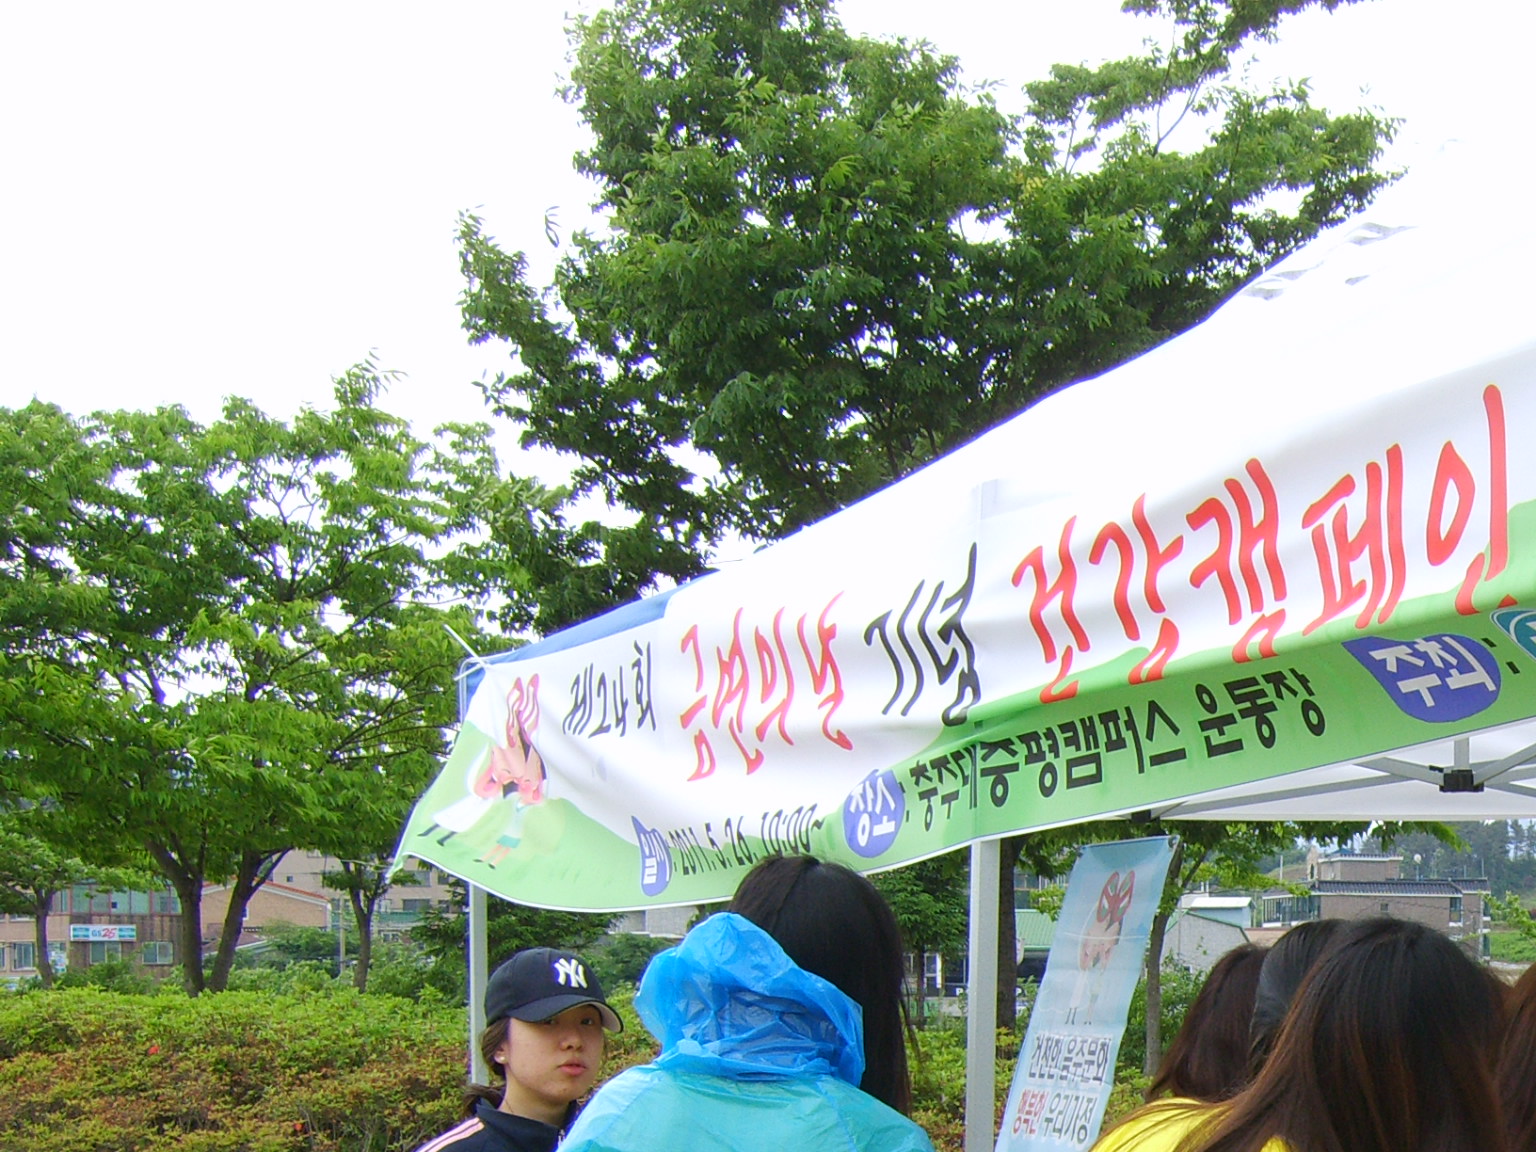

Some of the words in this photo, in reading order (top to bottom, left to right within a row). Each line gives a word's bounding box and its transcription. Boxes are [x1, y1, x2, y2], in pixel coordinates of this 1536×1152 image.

[563, 640, 656, 738] 제24회
[863, 542, 982, 727] 기념
[1367, 634, 1497, 708] 주최
[850, 776, 896, 848] 장소
[1195, 667, 1326, 760] 운동장
[1043, 1092, 1097, 1144] 우리가정
